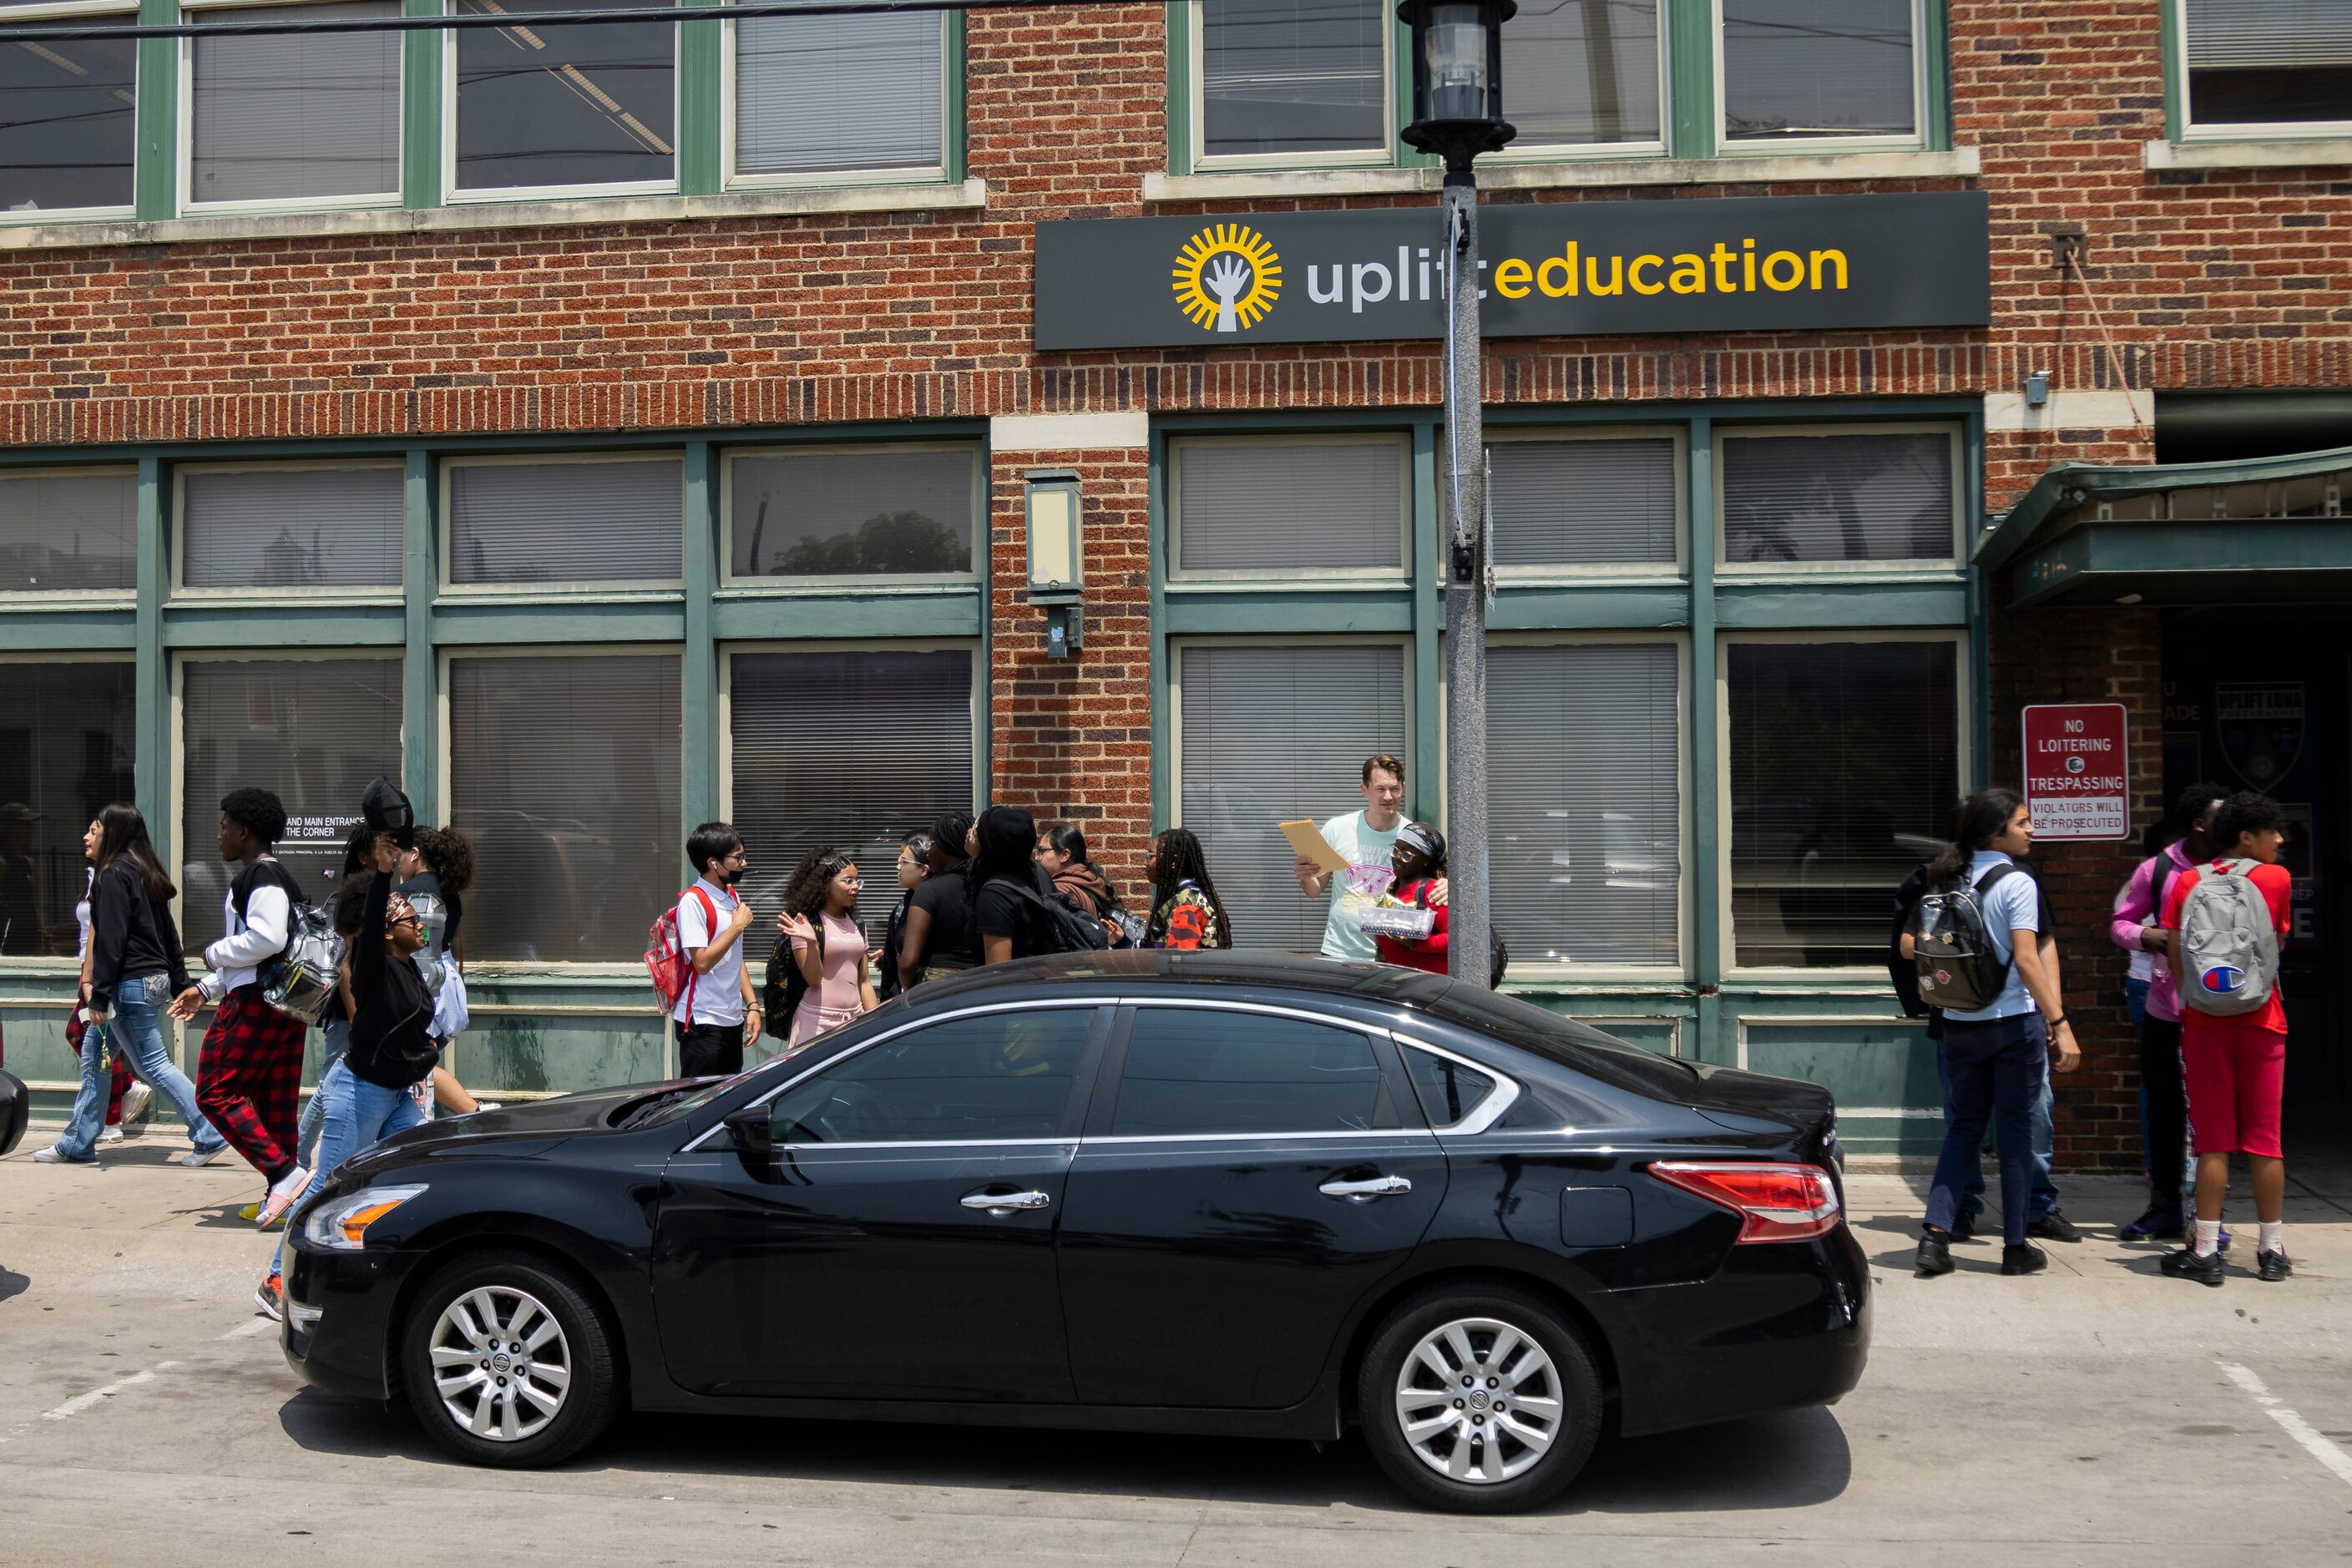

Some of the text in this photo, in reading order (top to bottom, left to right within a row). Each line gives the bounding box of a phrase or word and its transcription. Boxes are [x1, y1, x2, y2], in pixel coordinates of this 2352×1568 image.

[1308, 238, 1848, 314] upli education
[2163, 705, 2201, 721] ADE
[2065, 720, 2084, 733] NO
[2038, 738, 2112, 752] LOITERING
[2030, 776, 2123, 791] TRESPASSING
[2033, 802, 2122, 813] VIOLATORS WILL
[286, 817, 302, 826] AND
[304, 817, 323, 826] MAIN
[2034, 817, 2122, 829] BE PROSECUTED
[286, 827, 335, 837] THE CORNER
